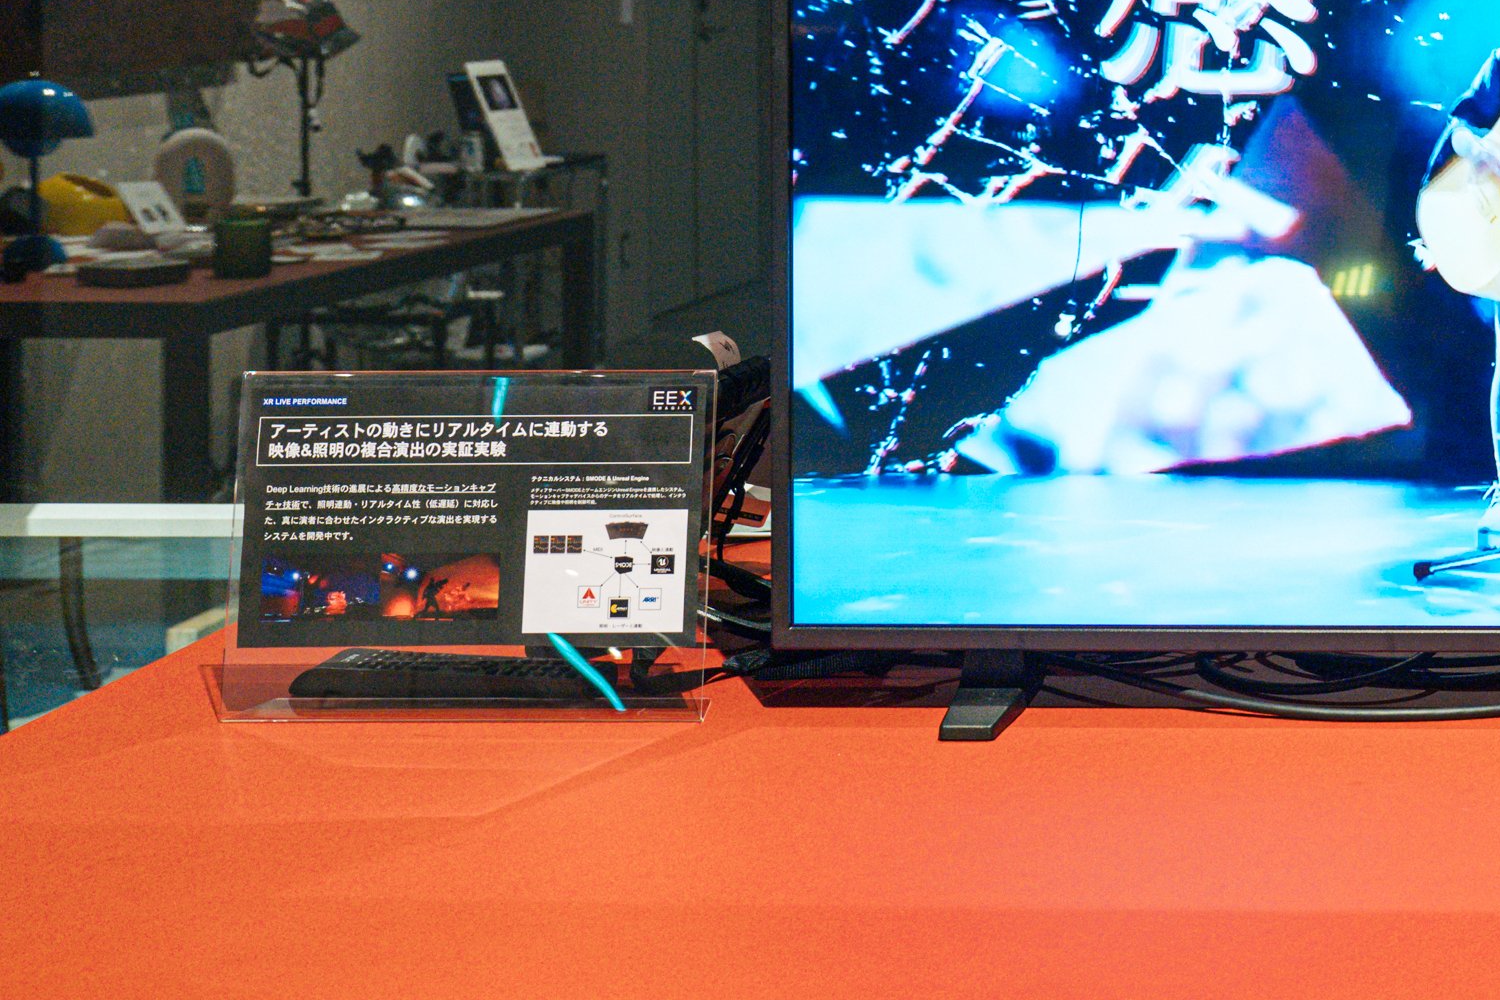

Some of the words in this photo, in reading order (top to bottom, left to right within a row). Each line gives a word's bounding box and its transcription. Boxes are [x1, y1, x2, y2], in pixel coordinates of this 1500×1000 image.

[263, 398, 274, 406] XR
[292, 397, 348, 405] PERFORMANCE
[653, 390, 692, 406] EEX
[270, 421, 609, 439] アーティストの動きにリアルタイムに連動する
[268, 441, 507, 459] 映像&照明の複合演出の実証実験
[266, 484, 288, 494] Deep
[263, 531, 354, 542] システムを開発中です。
